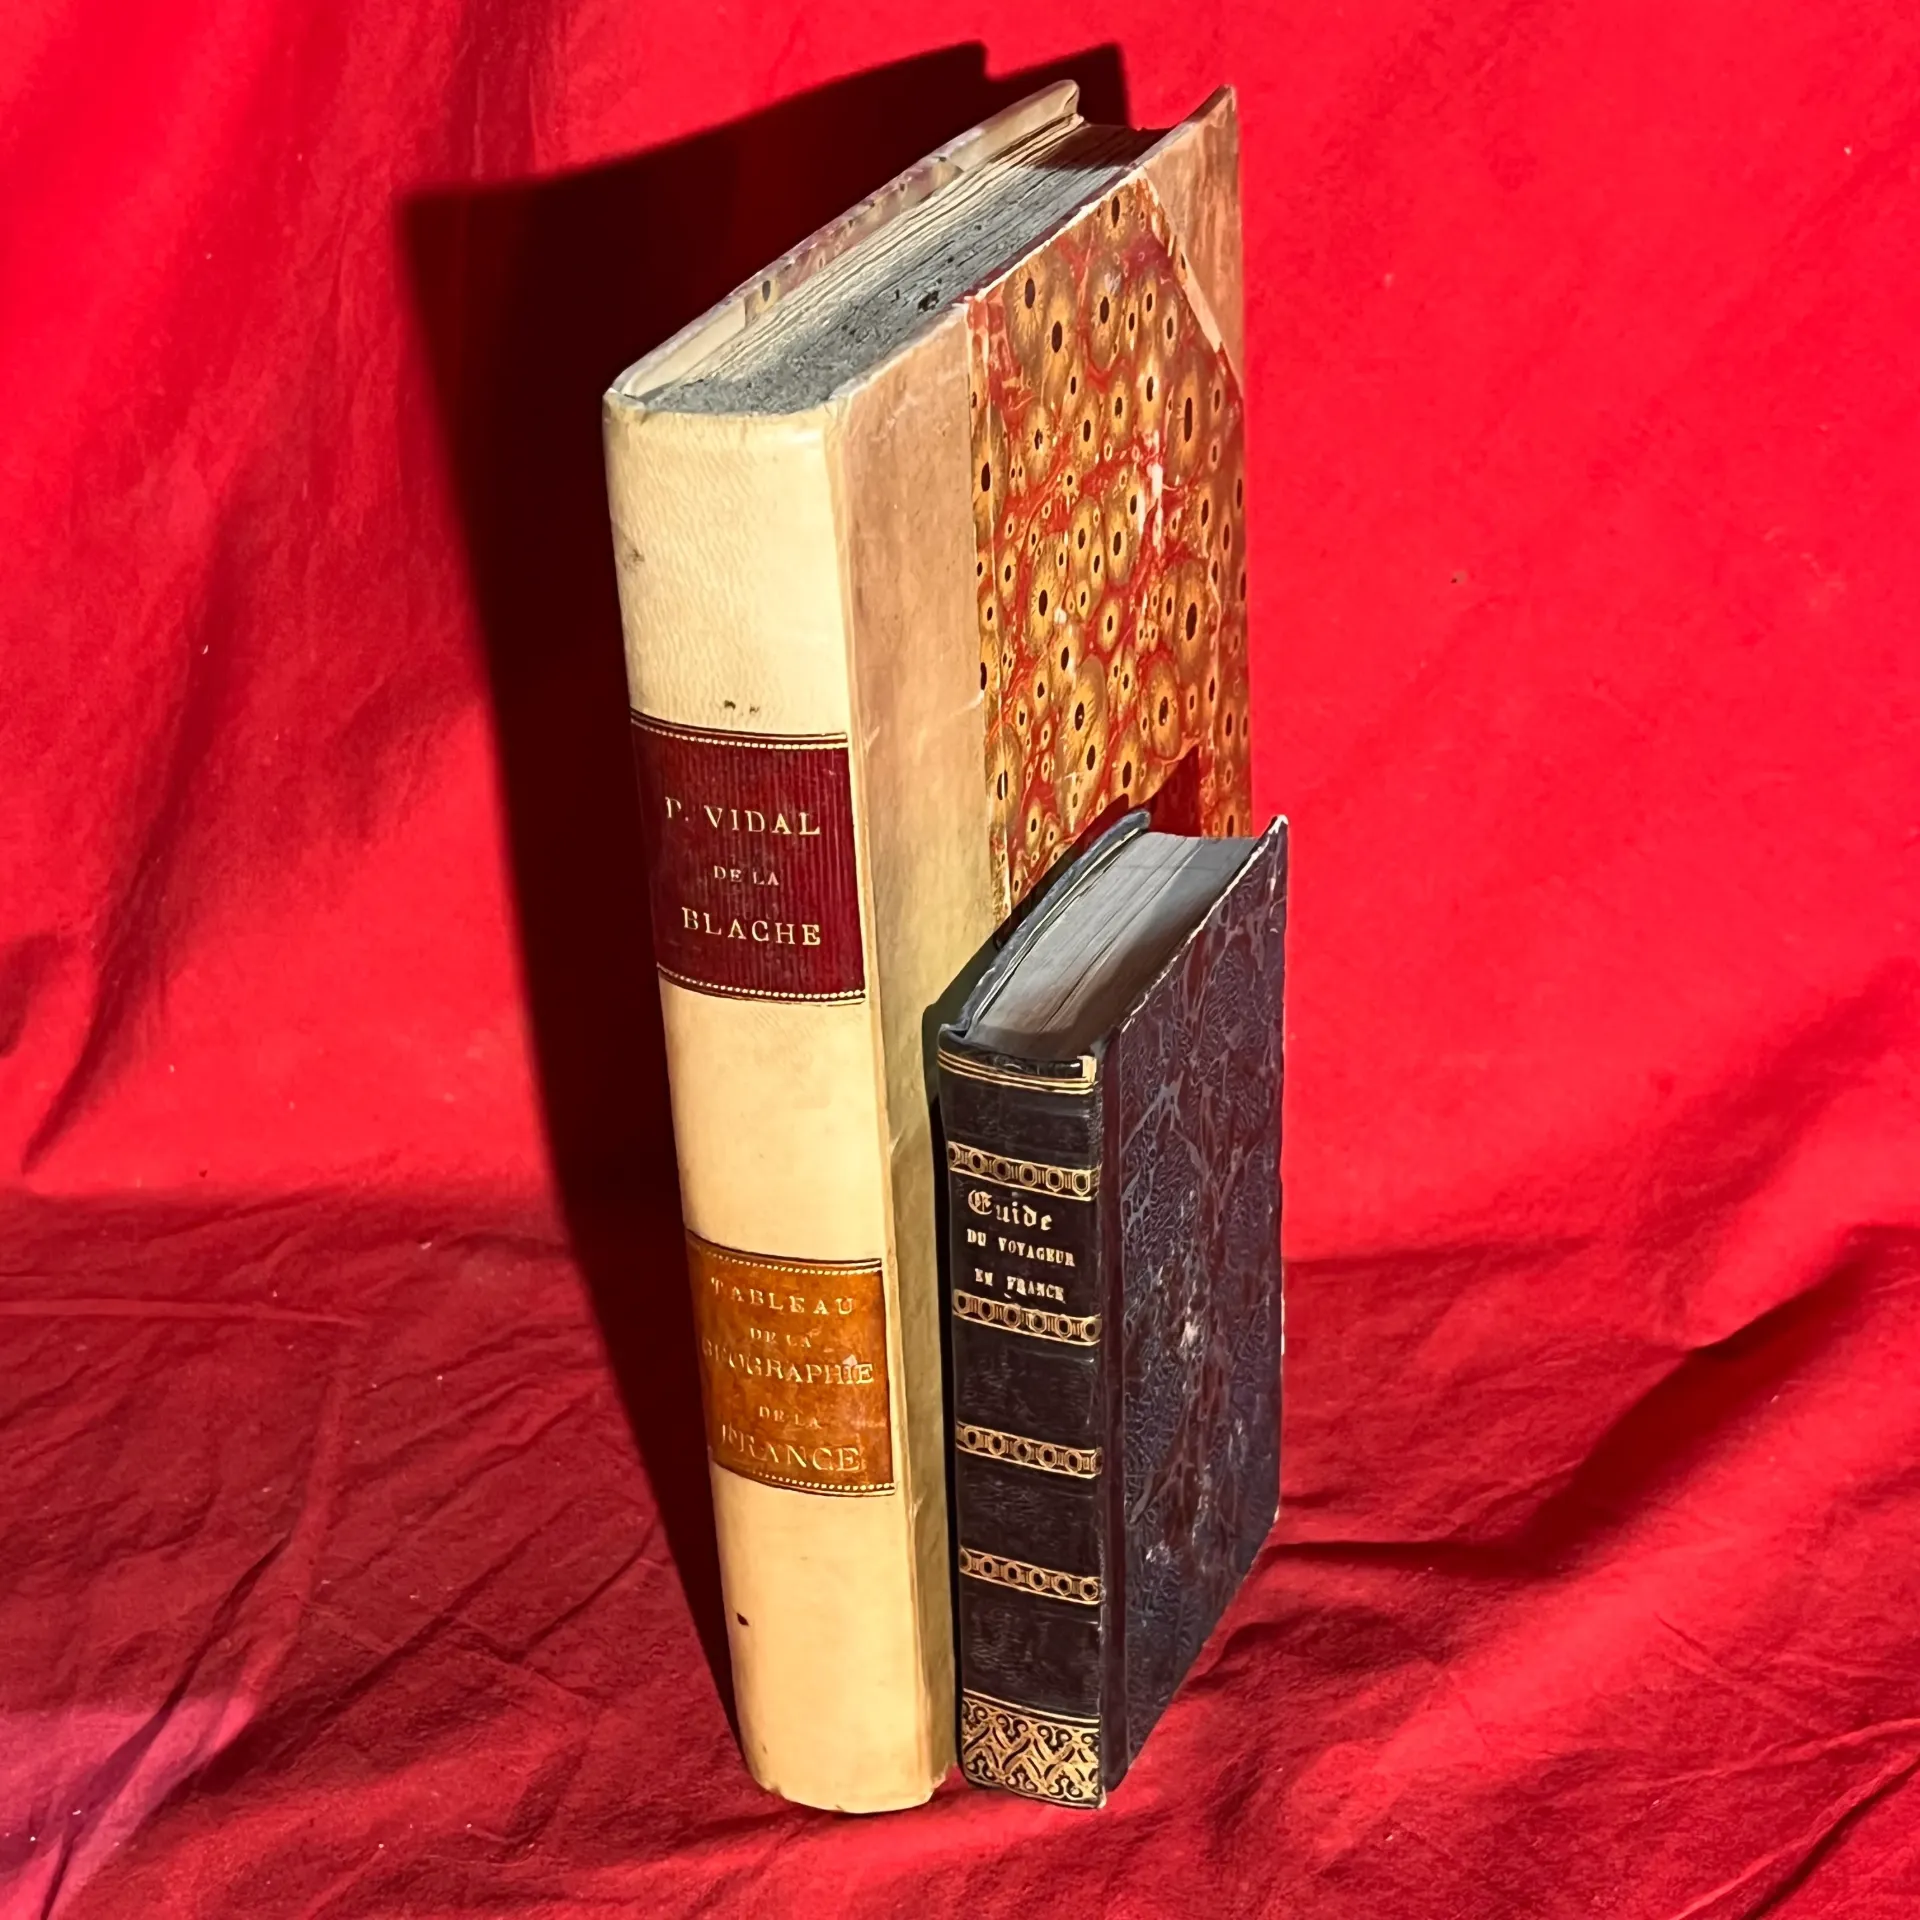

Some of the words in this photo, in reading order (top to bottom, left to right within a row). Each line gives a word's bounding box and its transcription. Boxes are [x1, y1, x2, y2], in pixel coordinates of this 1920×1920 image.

[703, 804, 821, 836] VIDAL
[713, 865, 742, 883] DE
[753, 871, 780, 886] LA
[681, 906, 821, 946] BLACHE
[967, 1189, 1053, 1231] Guide
[966, 1228, 987, 1247] DU
[998, 1237, 1076, 1267] VOYAGEUR
[710, 1276, 854, 1316] TABLEAU
[974, 1268, 993, 1287] EN
[1006, 1276, 1067, 1304] FRANCE
[750, 1327, 776, 1344] DE
[786, 1334, 812, 1349] LA
[759, 1405, 785, 1423] DE
[794, 1414, 822, 1429] LA
[721, 1424, 862, 1472] FRANCE
